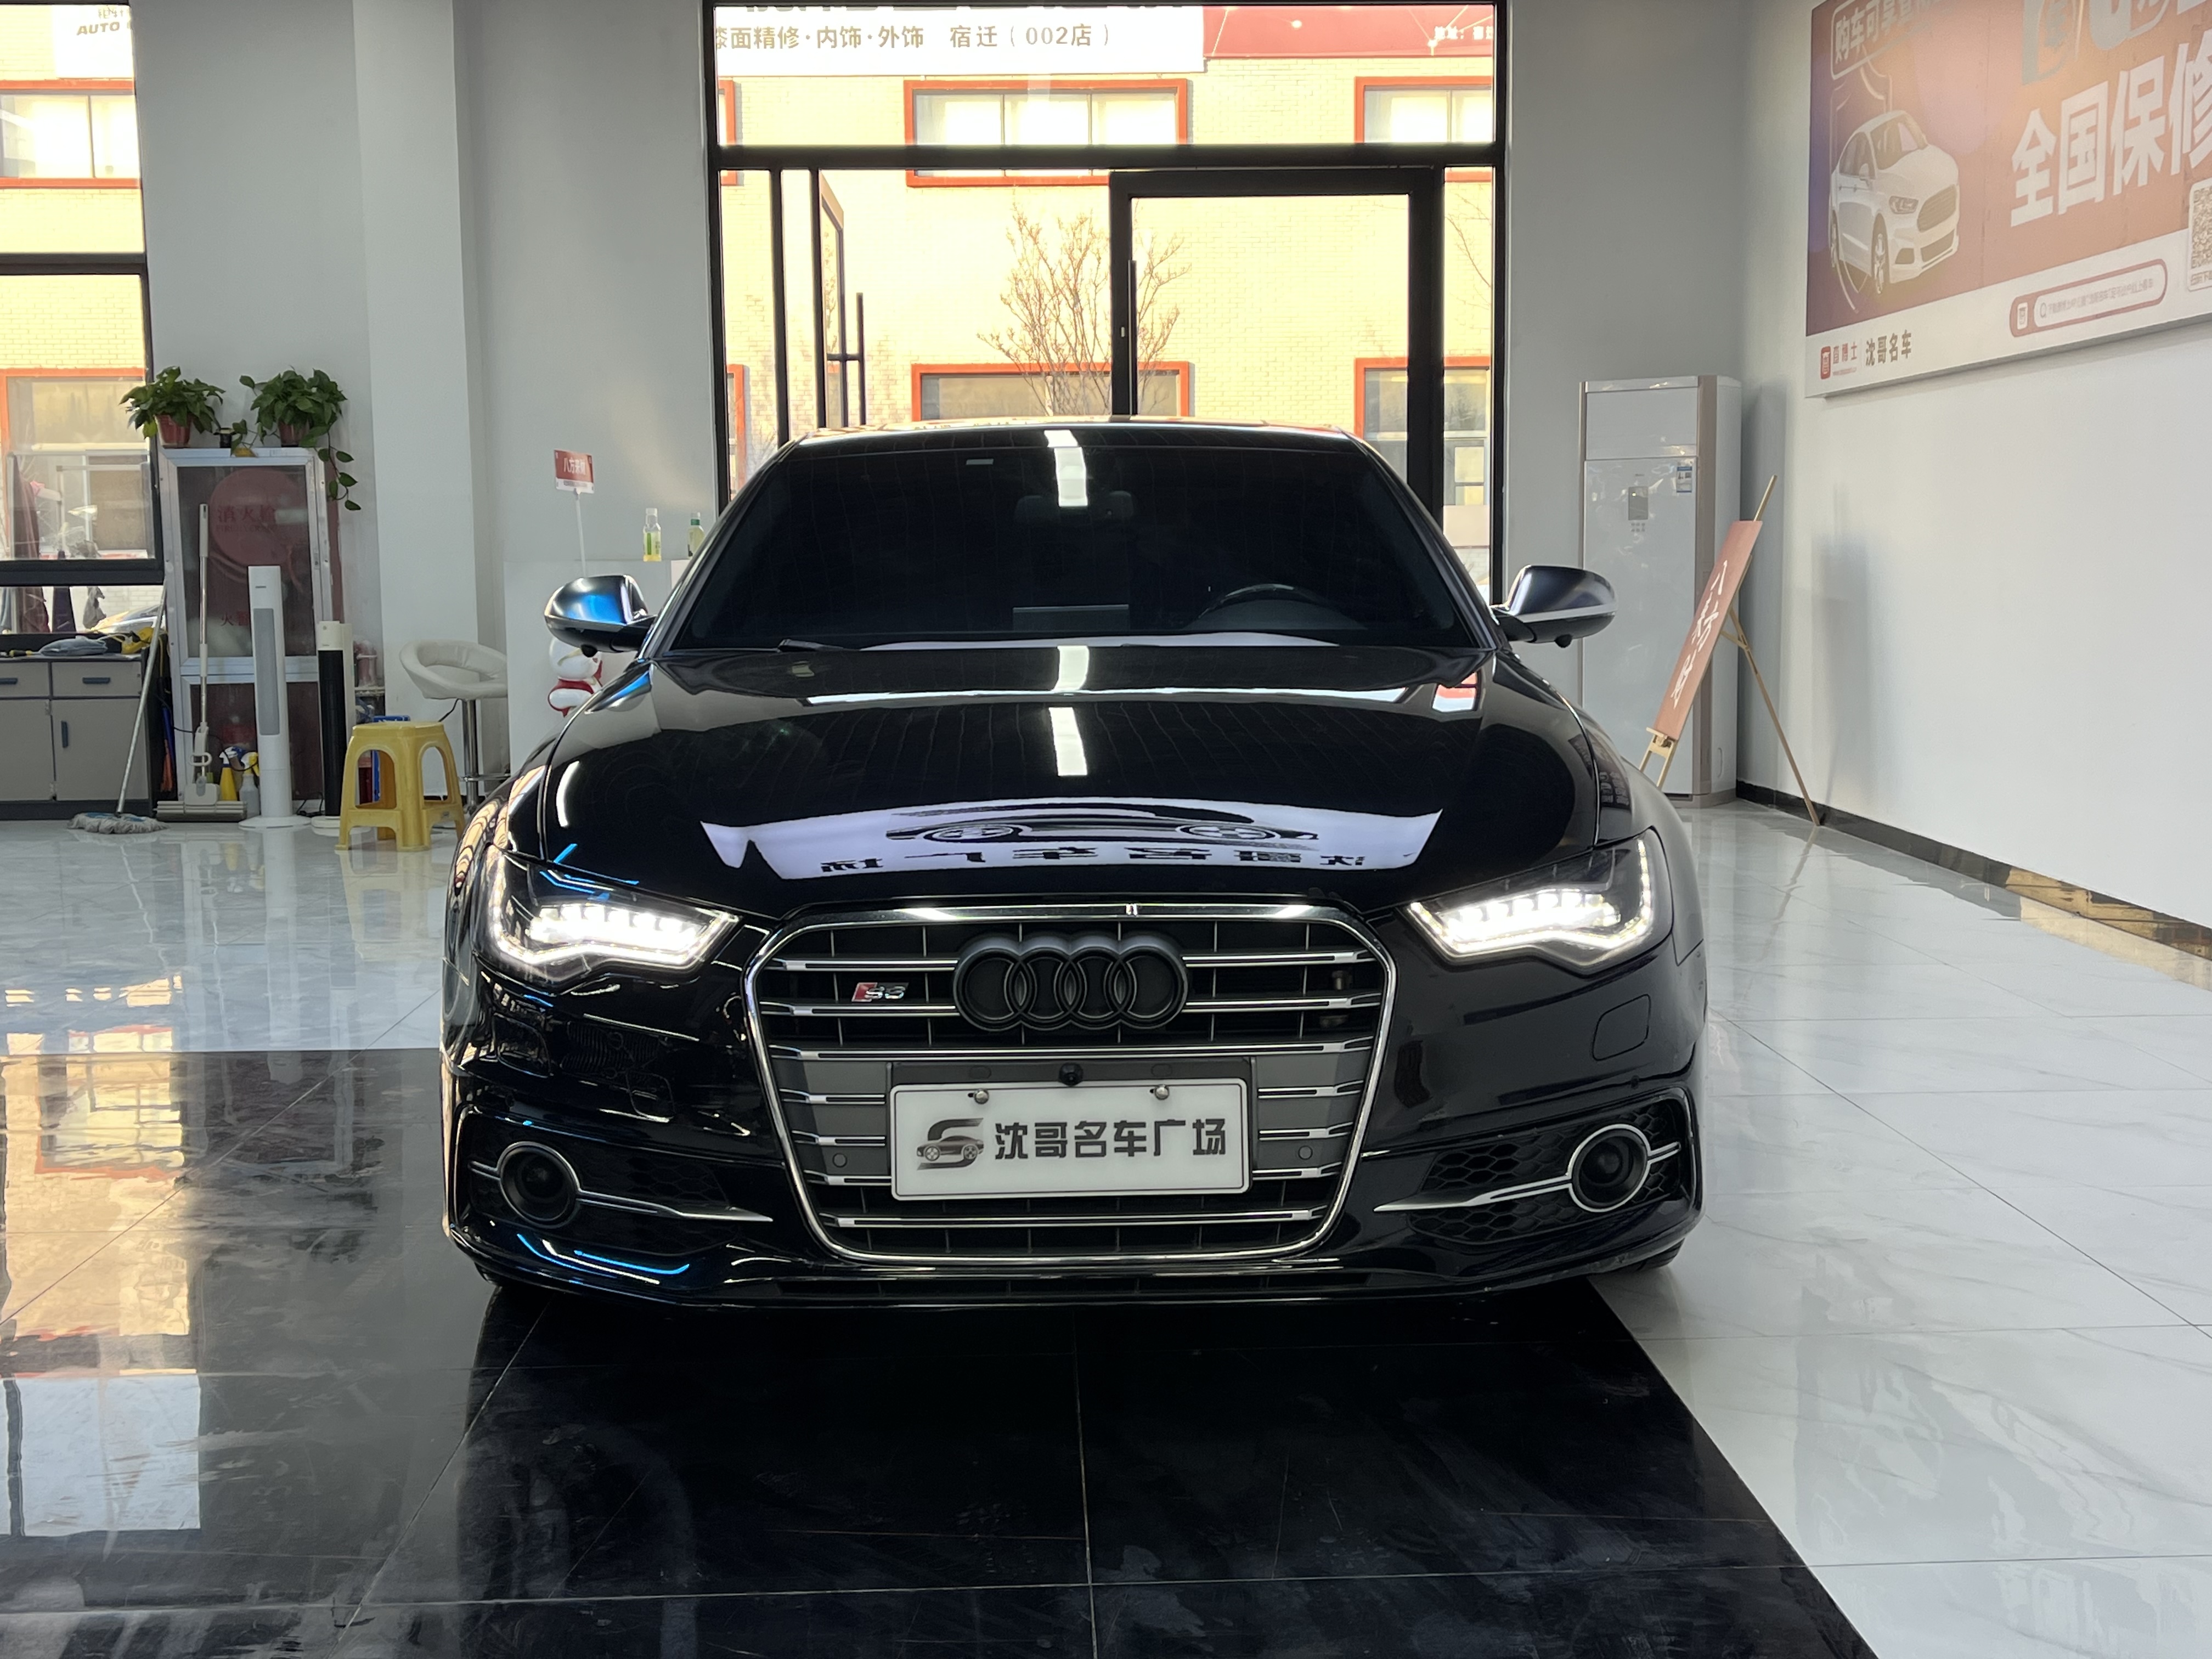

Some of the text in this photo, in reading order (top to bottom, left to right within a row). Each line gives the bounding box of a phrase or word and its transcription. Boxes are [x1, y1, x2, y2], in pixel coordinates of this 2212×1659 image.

[76, 21, 120, 36] AUTO
[1865, 329, 1912, 366] 沈哥名车
[865, 986, 906, 1000] S6
[995, 1118, 1226, 1160] 沈哥名车广场
